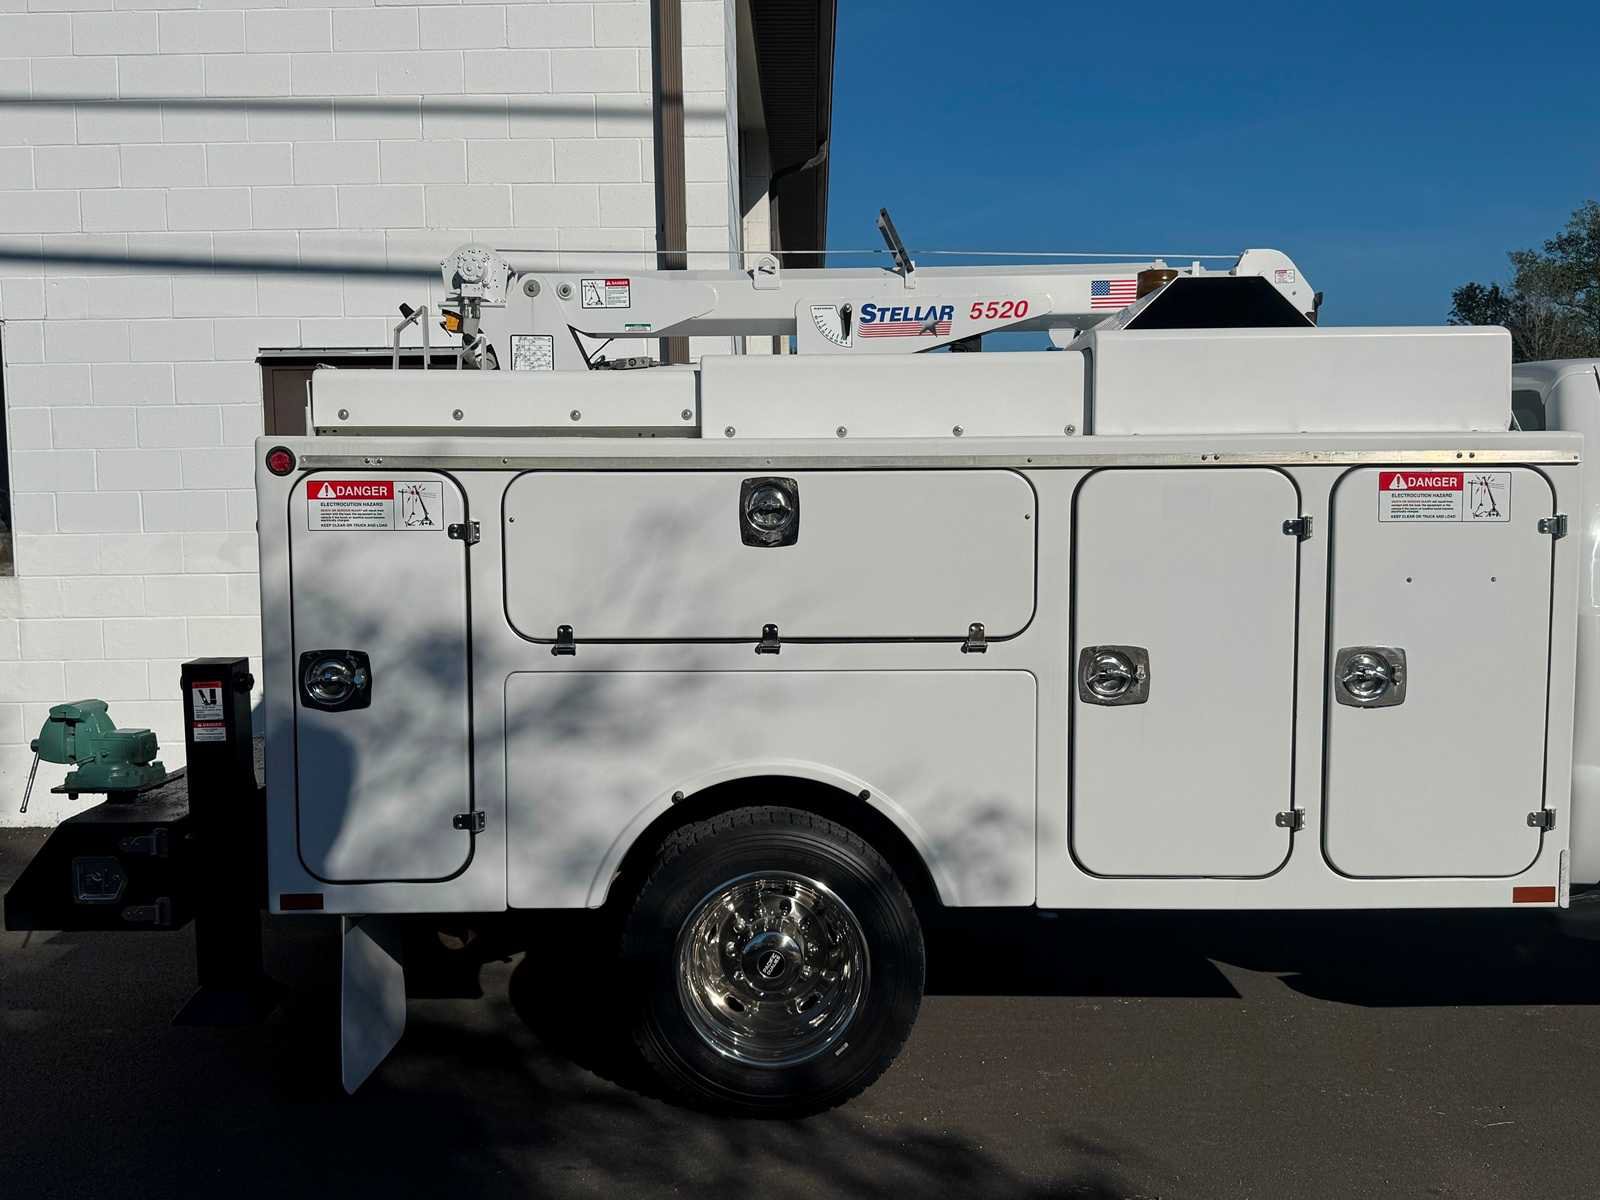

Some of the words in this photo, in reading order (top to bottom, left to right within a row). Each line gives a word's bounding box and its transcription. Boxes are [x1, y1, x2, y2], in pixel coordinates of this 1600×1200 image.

[859, 303, 955, 323] STELLAR
[969, 300, 1029, 319] 5520
[1408, 477, 1457, 487] DANGER
[336, 486, 388, 496] DANGER
